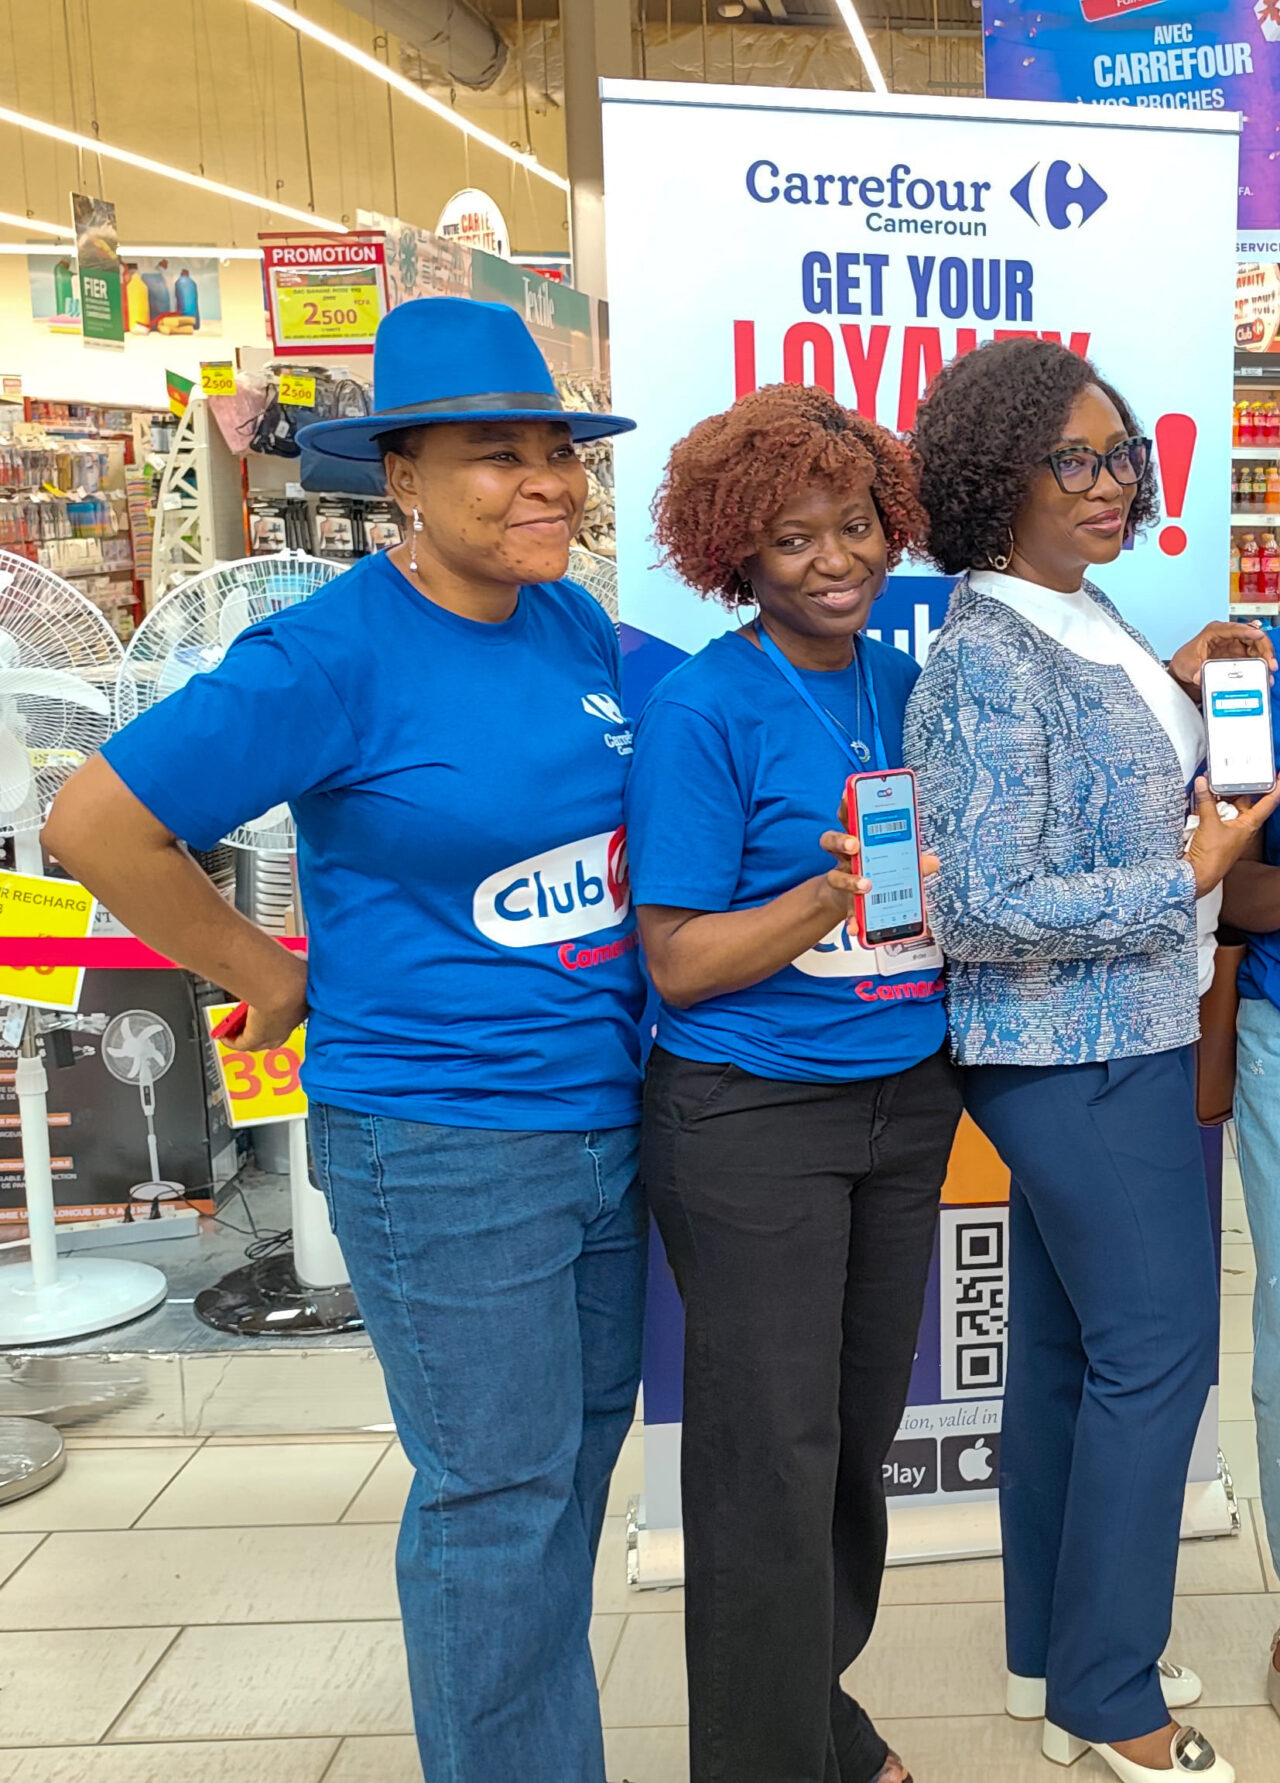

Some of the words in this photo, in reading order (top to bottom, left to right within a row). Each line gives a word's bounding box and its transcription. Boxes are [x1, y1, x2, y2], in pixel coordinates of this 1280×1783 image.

[1154, 23, 1193, 45] AVEC
[1093, 42, 1254, 88] CARREFOUR
[745, 159, 992, 213] Carrefour
[865, 212, 988, 237] Cameroun
[271, 246, 377, 264] PROMOTION
[83, 276, 108, 300] FIER
[801, 250, 890, 316] GET
[906, 255, 1034, 322] YOUR
[522, 276, 555, 330] Textile
[733, 319, 1091, 433] LOYA
[12, 889, 88, 913] RECHARG
[494, 859, 605, 922] Club
[898, 1413, 934, 1431] ion,
[939, 1406, 980, 1428] valid
[982, 1408, 998, 1425] in
[881, 1462, 926, 1489] Play
